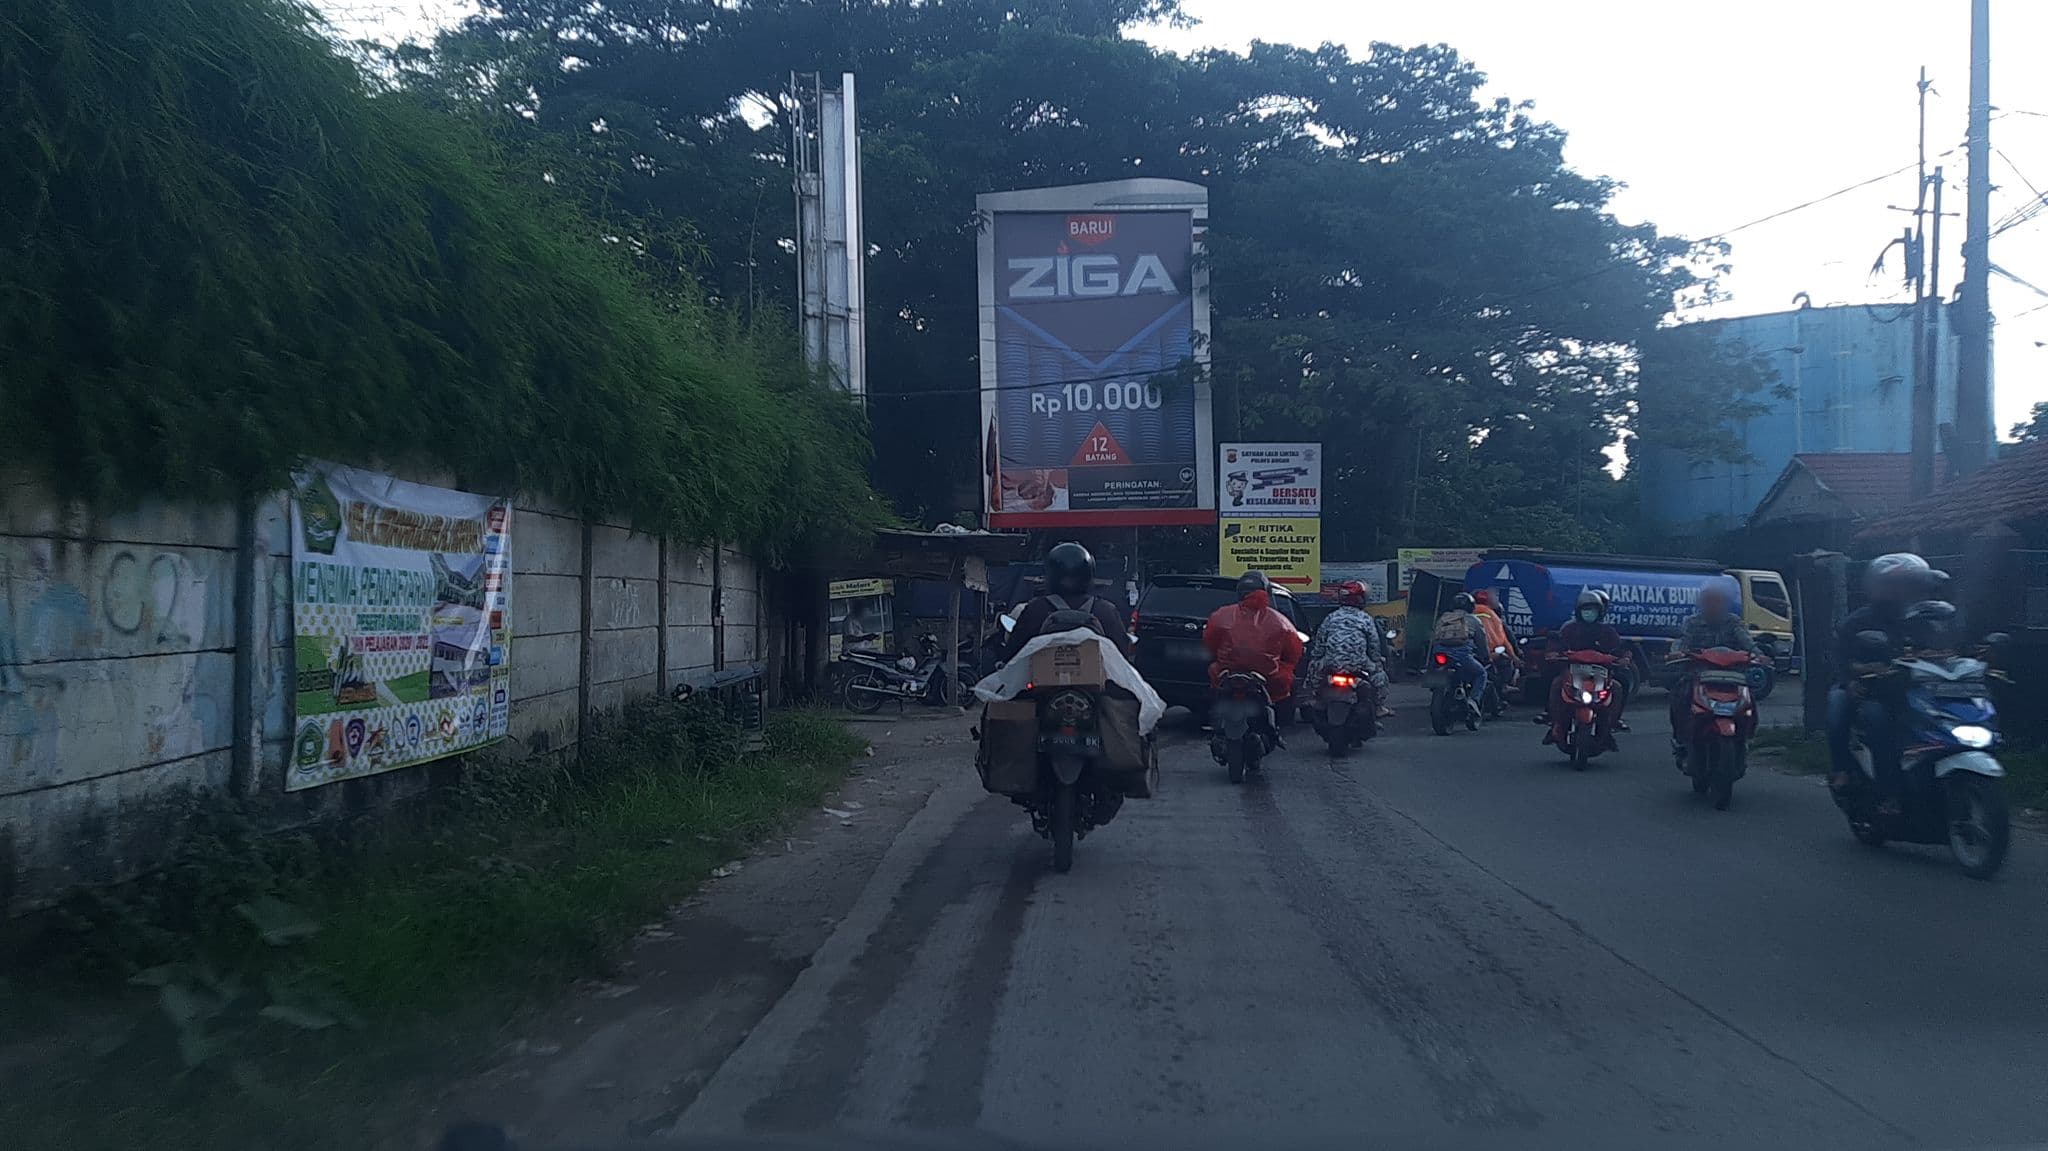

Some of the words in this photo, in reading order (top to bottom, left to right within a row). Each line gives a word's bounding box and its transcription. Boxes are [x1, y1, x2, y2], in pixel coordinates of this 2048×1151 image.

[1008, 254, 1179, 297] ZIGA
[1031, 382, 1162, 418] Rp10.000
[1092, 437, 1108, 452] 12
[1085, 452, 1117, 462] BATANG
[1273, 488, 1317, 498] BERSATU
[1246, 498, 1297, 506] KESELAMATAN
[1258, 525, 1294, 533] RITIKA
[1232, 536, 1267, 544] STONE
[1269, 536, 1316, 544] GALLERY
[1602, 583, 1666, 603] TARATAK
